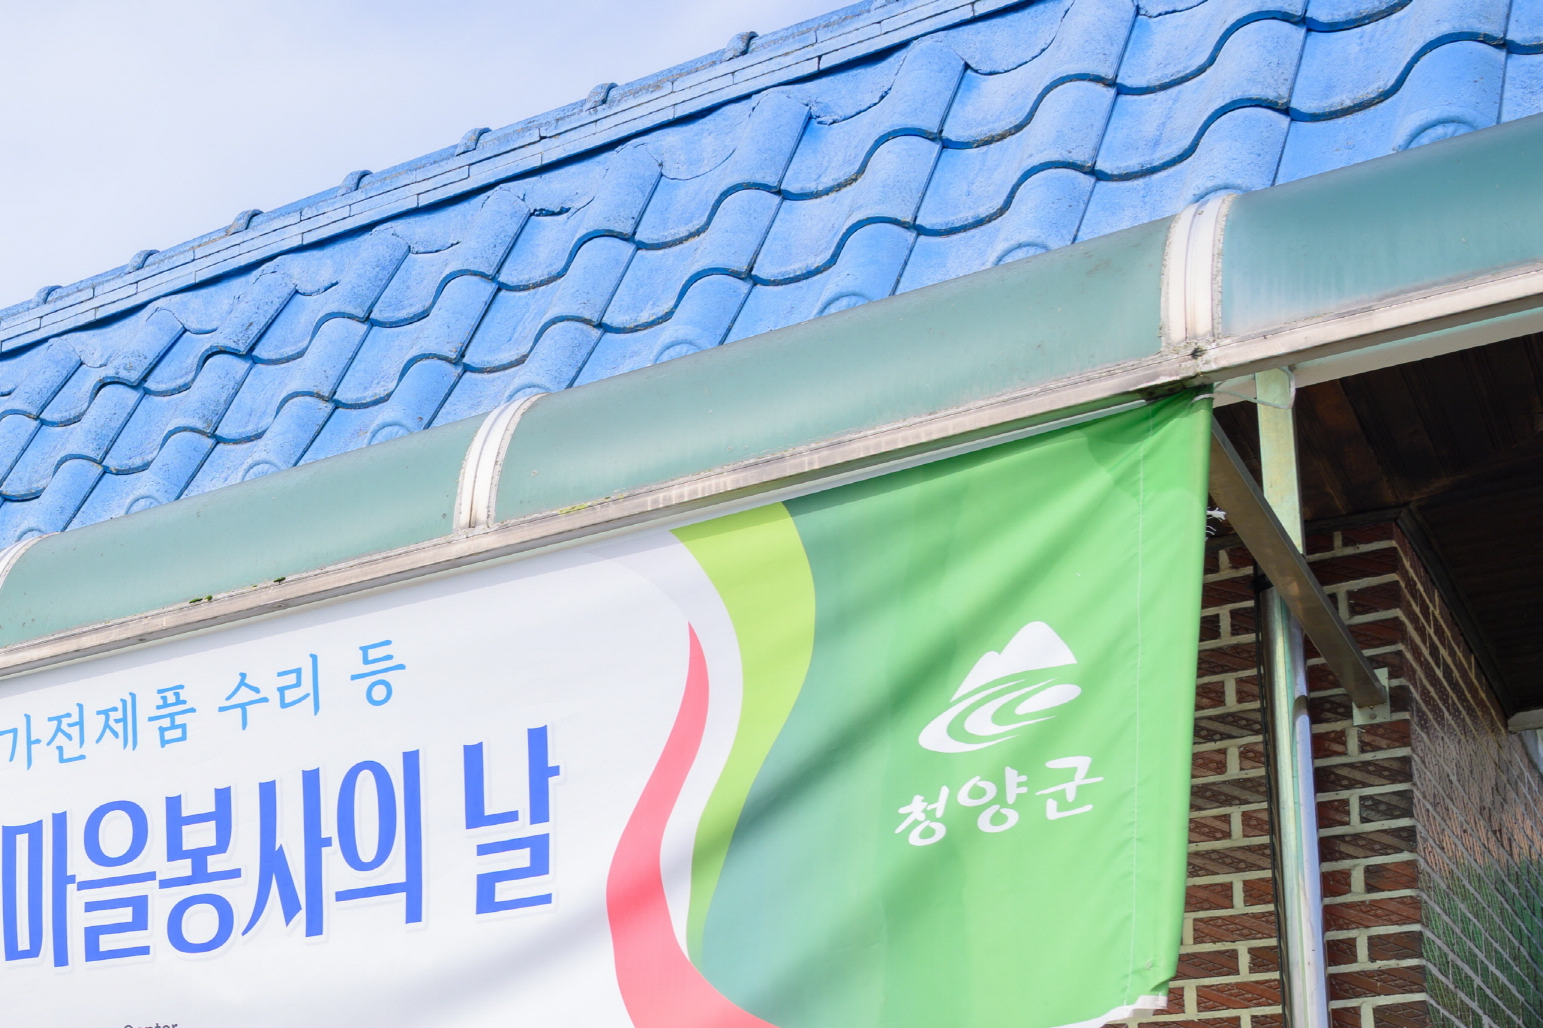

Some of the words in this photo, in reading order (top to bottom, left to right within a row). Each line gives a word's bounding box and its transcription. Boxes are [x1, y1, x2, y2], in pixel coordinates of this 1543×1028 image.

[217, 653, 321, 731] 수리
[350, 639, 407, 707] 등
[1, 747, 426, 969] 마을봉사의
[462, 724, 561, 916] 날
[893, 755, 1105, 847] 청양군
